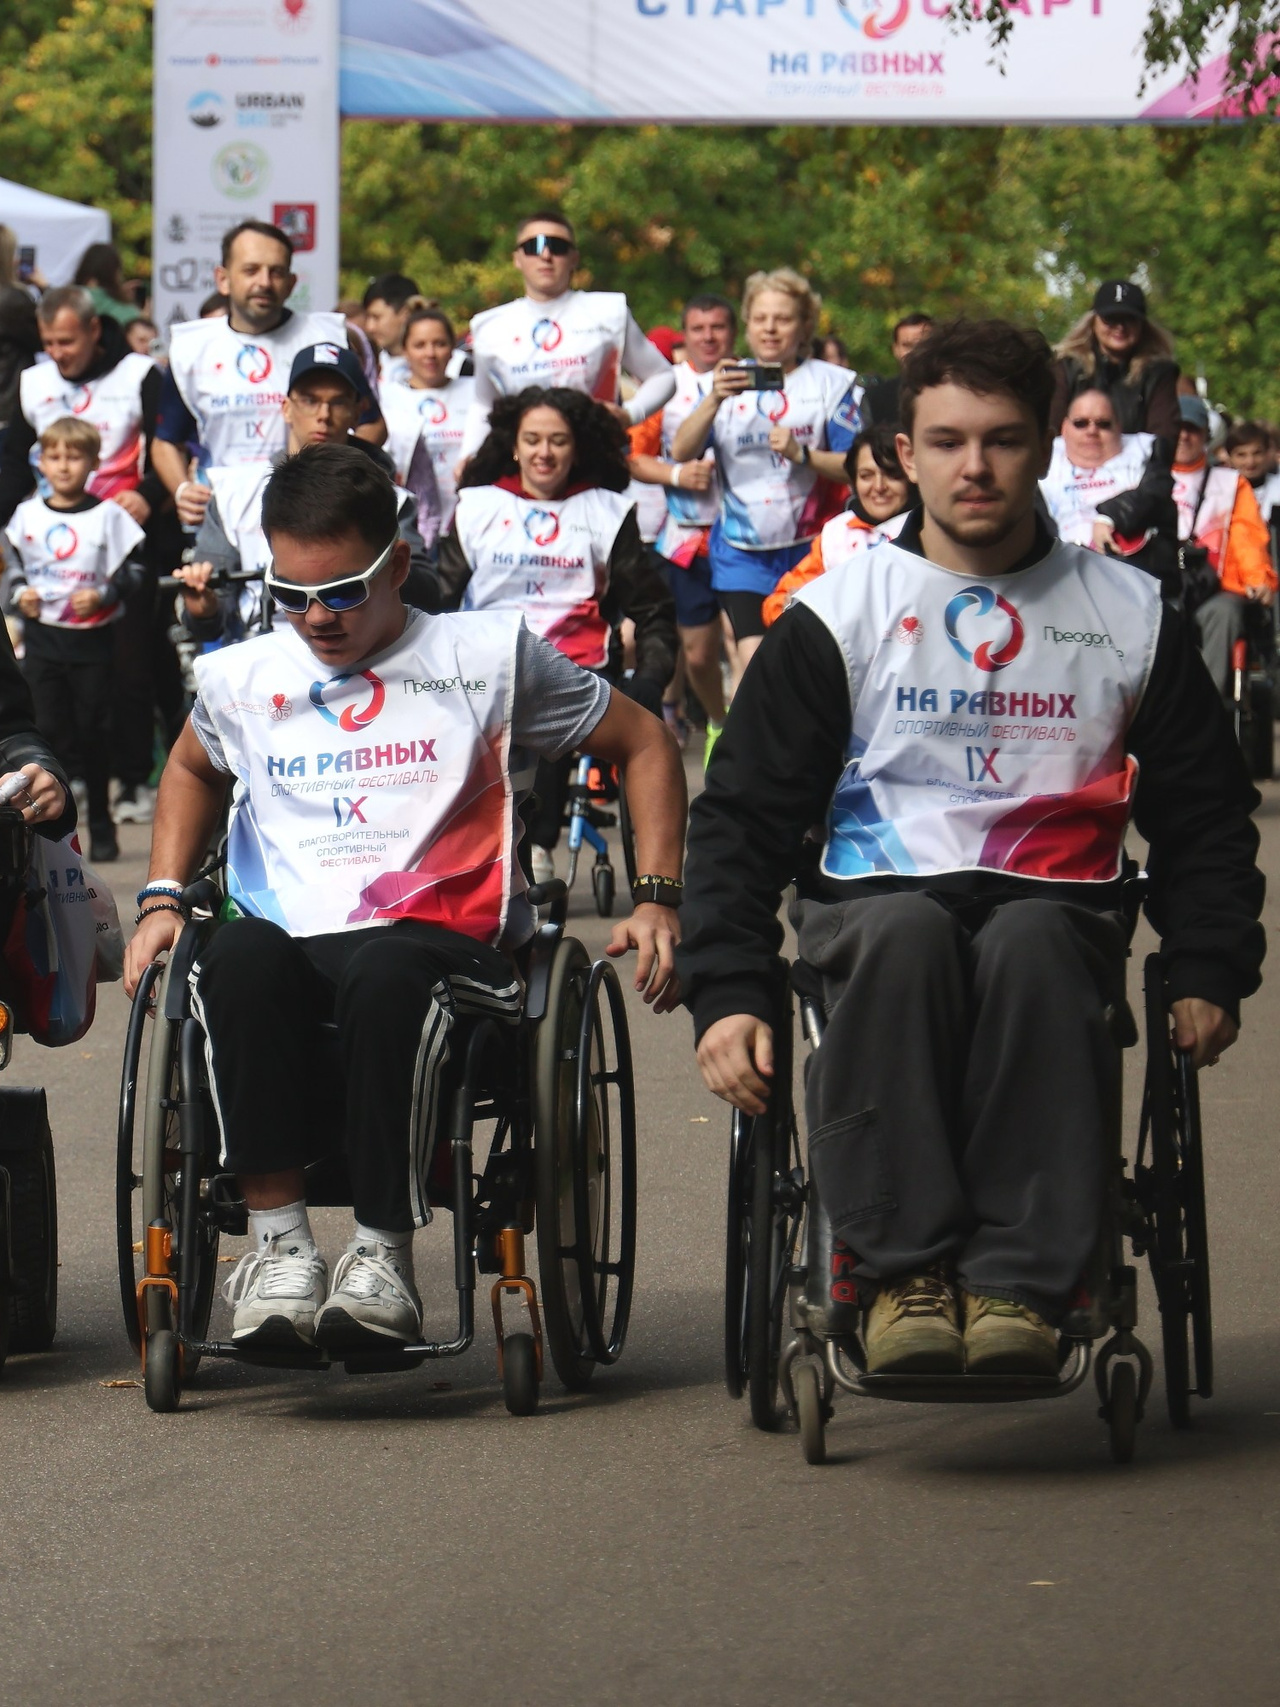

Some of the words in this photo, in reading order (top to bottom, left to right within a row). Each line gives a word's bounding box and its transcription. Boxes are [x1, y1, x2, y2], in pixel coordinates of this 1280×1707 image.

[770, 52, 809, 74] НА
[822, 52, 945, 75] РАВНЫХ
[235, 91, 305, 110] URBAN
[520, 554, 585, 568] РАВНЫХ
[526, 581, 546, 596] IX
[897, 687, 938, 712] НА
[950, 689, 1077, 718] РАВНЫХ
[895, 720, 990, 738] СПОРТИВНЫЙ
[991, 725, 1077, 742] ФЕСТИВАЛЬ
[267, 756, 306, 777] НА
[317, 739, 438, 775] РАВНЫХ
[966, 746, 1002, 783] IX
[271, 778, 356, 797] СПОРТИВНЫЙ
[358, 770, 439, 788] ФЕСТИВАЛЬ
[333, 796, 368, 827] IX
[298, 829, 410, 849] БЛАГОТВОРИТЕЛЬНЫЙ
[316, 843, 387, 858] СПОРТИВНЫЙ
[320, 855, 382, 868] ФЕСТИВАЛЬ
